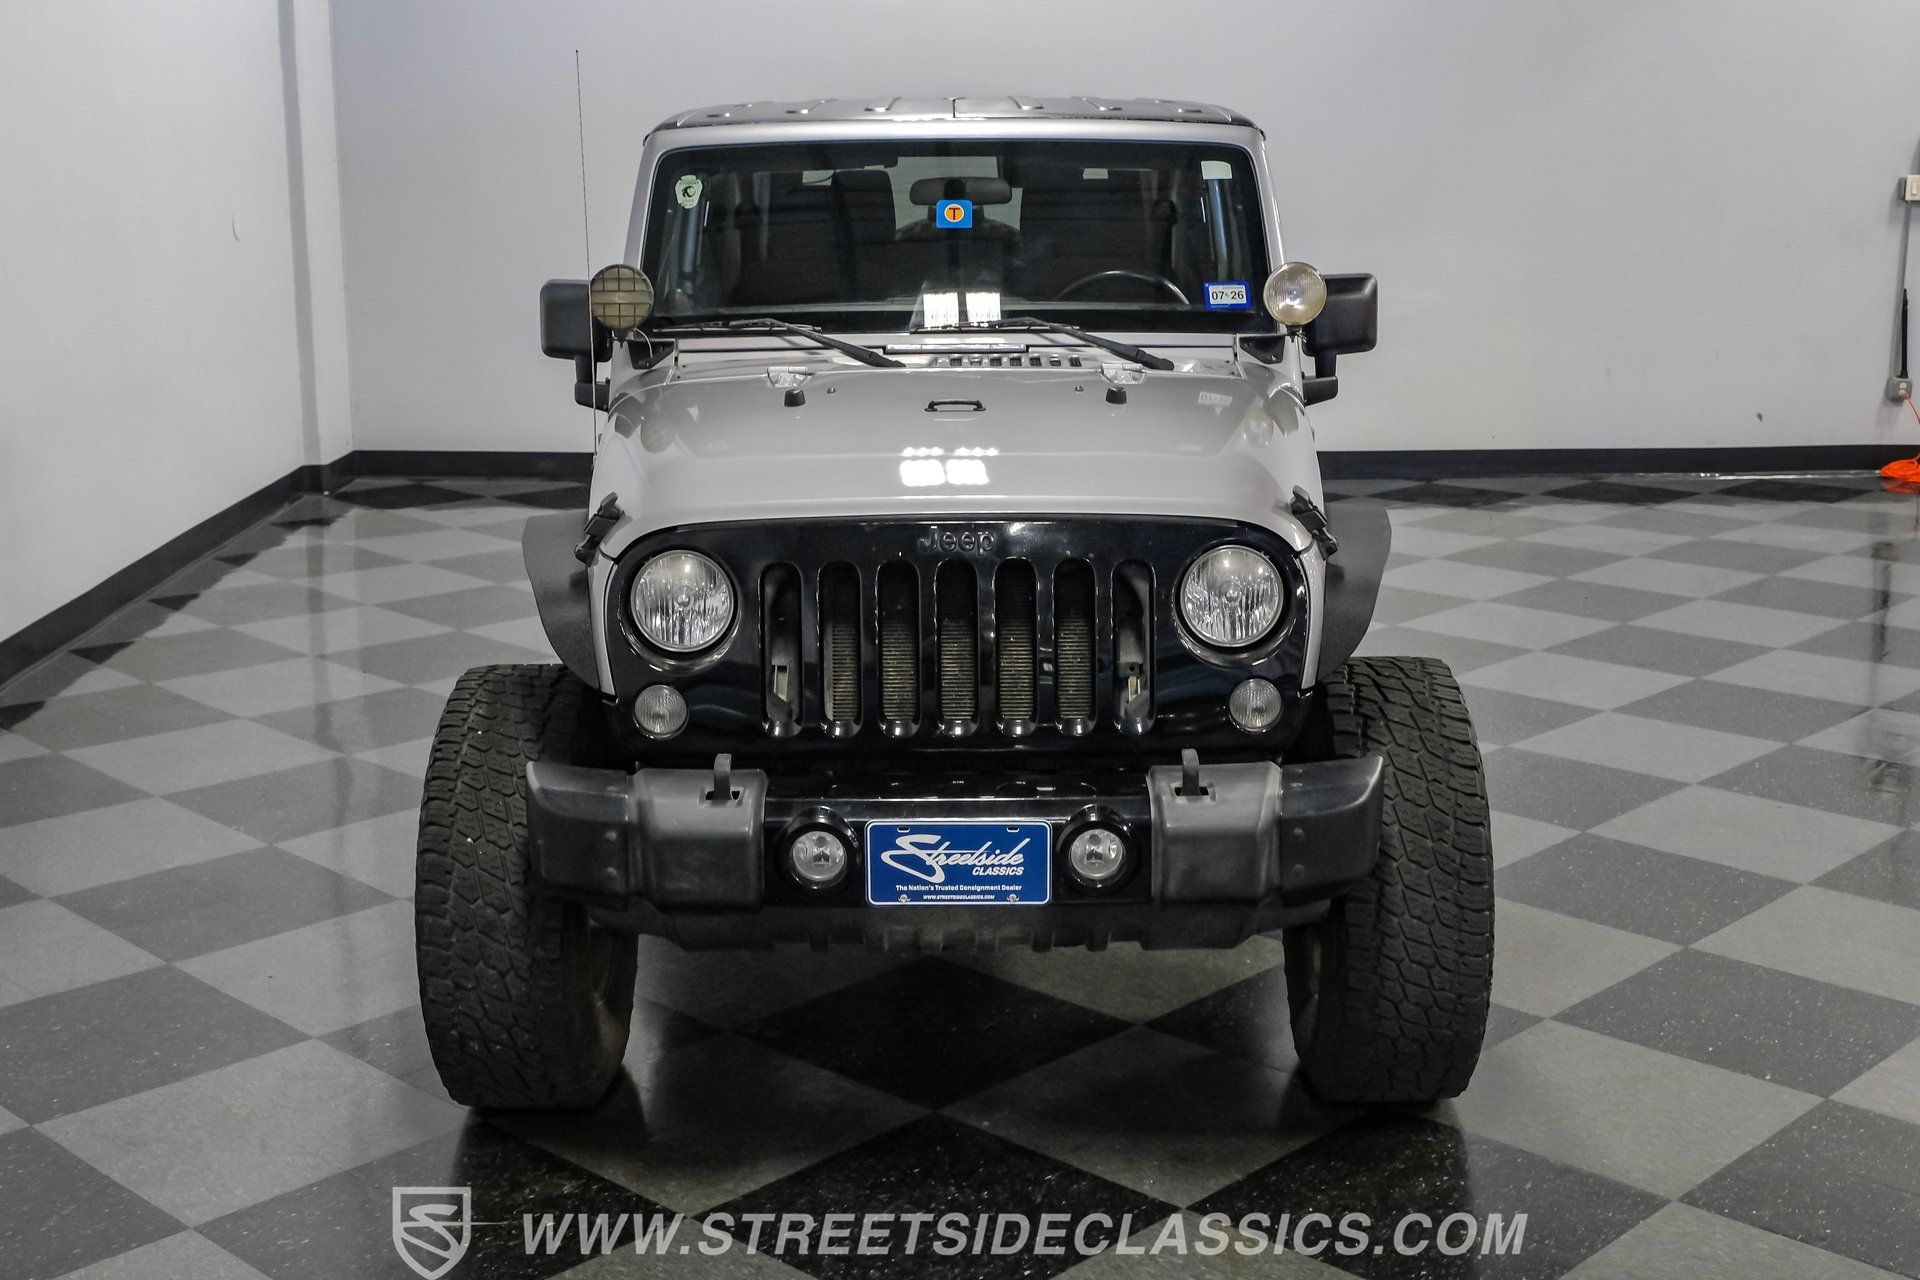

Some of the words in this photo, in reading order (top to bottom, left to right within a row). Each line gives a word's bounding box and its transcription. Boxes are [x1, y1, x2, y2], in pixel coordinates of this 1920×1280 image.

[949, 207, 961, 221] T
[1211, 291, 1225, 300] 07
[1230, 290, 1244, 300] 26
[917, 525, 996, 556] Jeep
[880, 833, 1031, 884] Streetside
[972, 866, 1024, 876] CLASSICS
[959, 884, 1000, 892] Consignment
